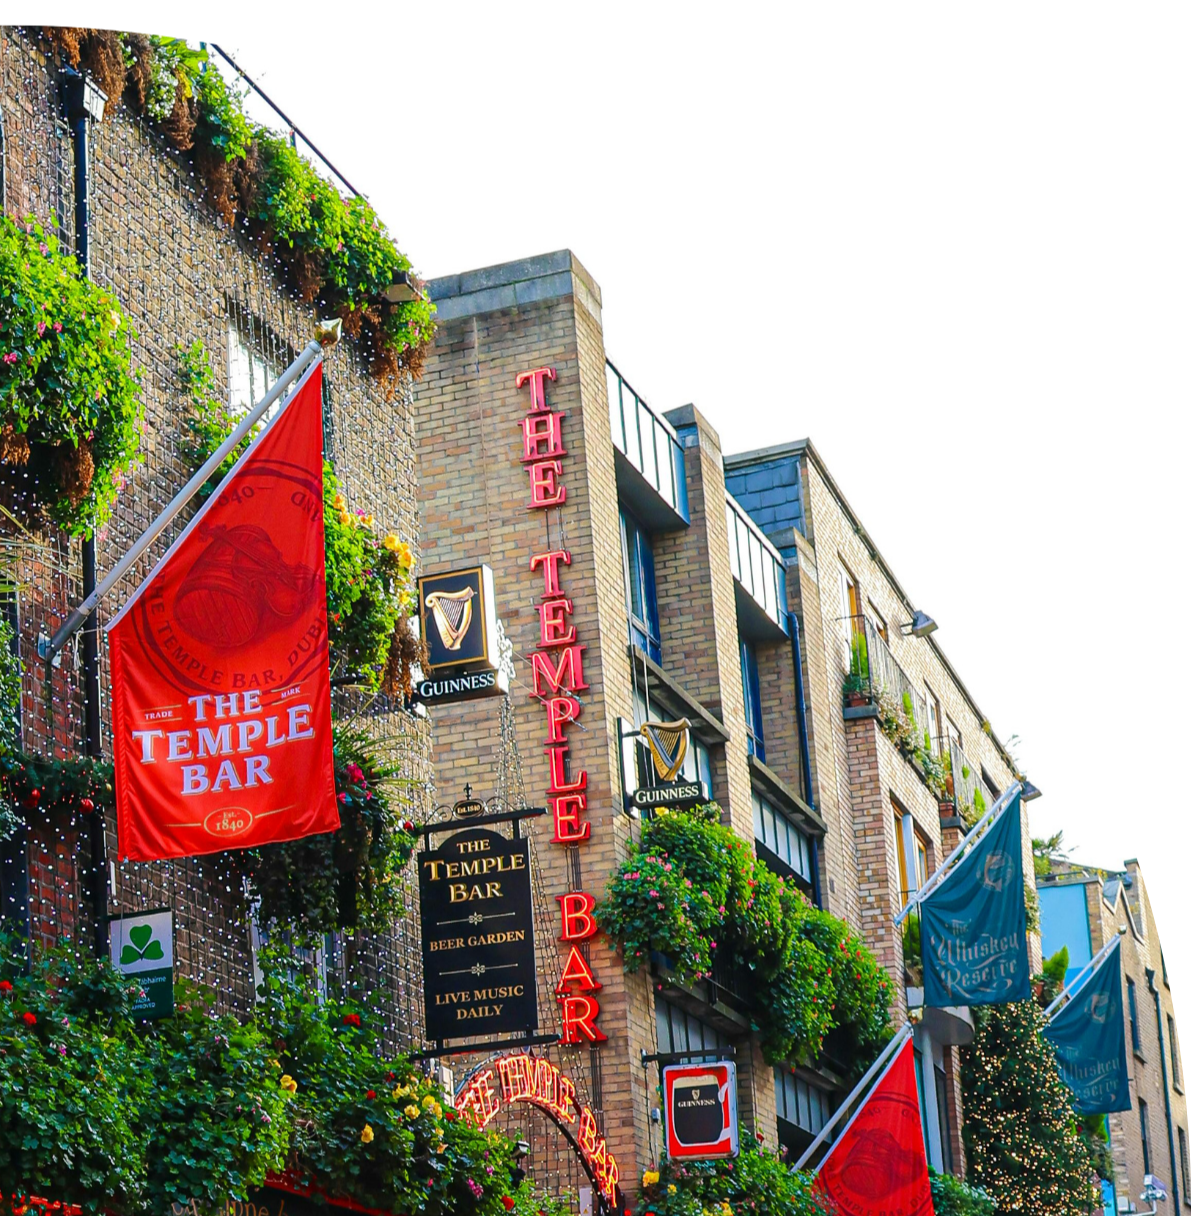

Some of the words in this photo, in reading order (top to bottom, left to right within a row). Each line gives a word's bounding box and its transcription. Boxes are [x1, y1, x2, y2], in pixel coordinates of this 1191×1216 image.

[515, 366, 566, 509] THE
[157, 621, 223, 688] TEMPLE
[280, 686, 301, 699] MARK
[420, 672, 496, 698] GUINNESS
[526, 550, 592, 844] TEMPLE
[144, 710, 174, 720] TRADE
[188, 689, 263, 722] THE
[132, 704, 315, 764] TEMPLE
[180, 755, 274, 796] BAR
[635, 785, 699, 804] GUINNESS
[216, 819, 244, 832] 1840
[456, 839, 491, 854] THE
[424, 853, 526, 881] TEMPLE
[448, 882, 504, 903] BAR
[429, 938, 464, 952] BEER
[467, 930, 526, 947] GARDEN
[555, 892, 608, 1045] BAR
[435, 991, 471, 1005] LIVE
[474, 985, 525, 1002] MUSIC
[456, 1004, 504, 1020] DAILY
[678, 1098, 716, 1108] GUINNESS
[495, 1053, 577, 1124] TEMPLE
[577, 1106, 619, 1208] BAR
